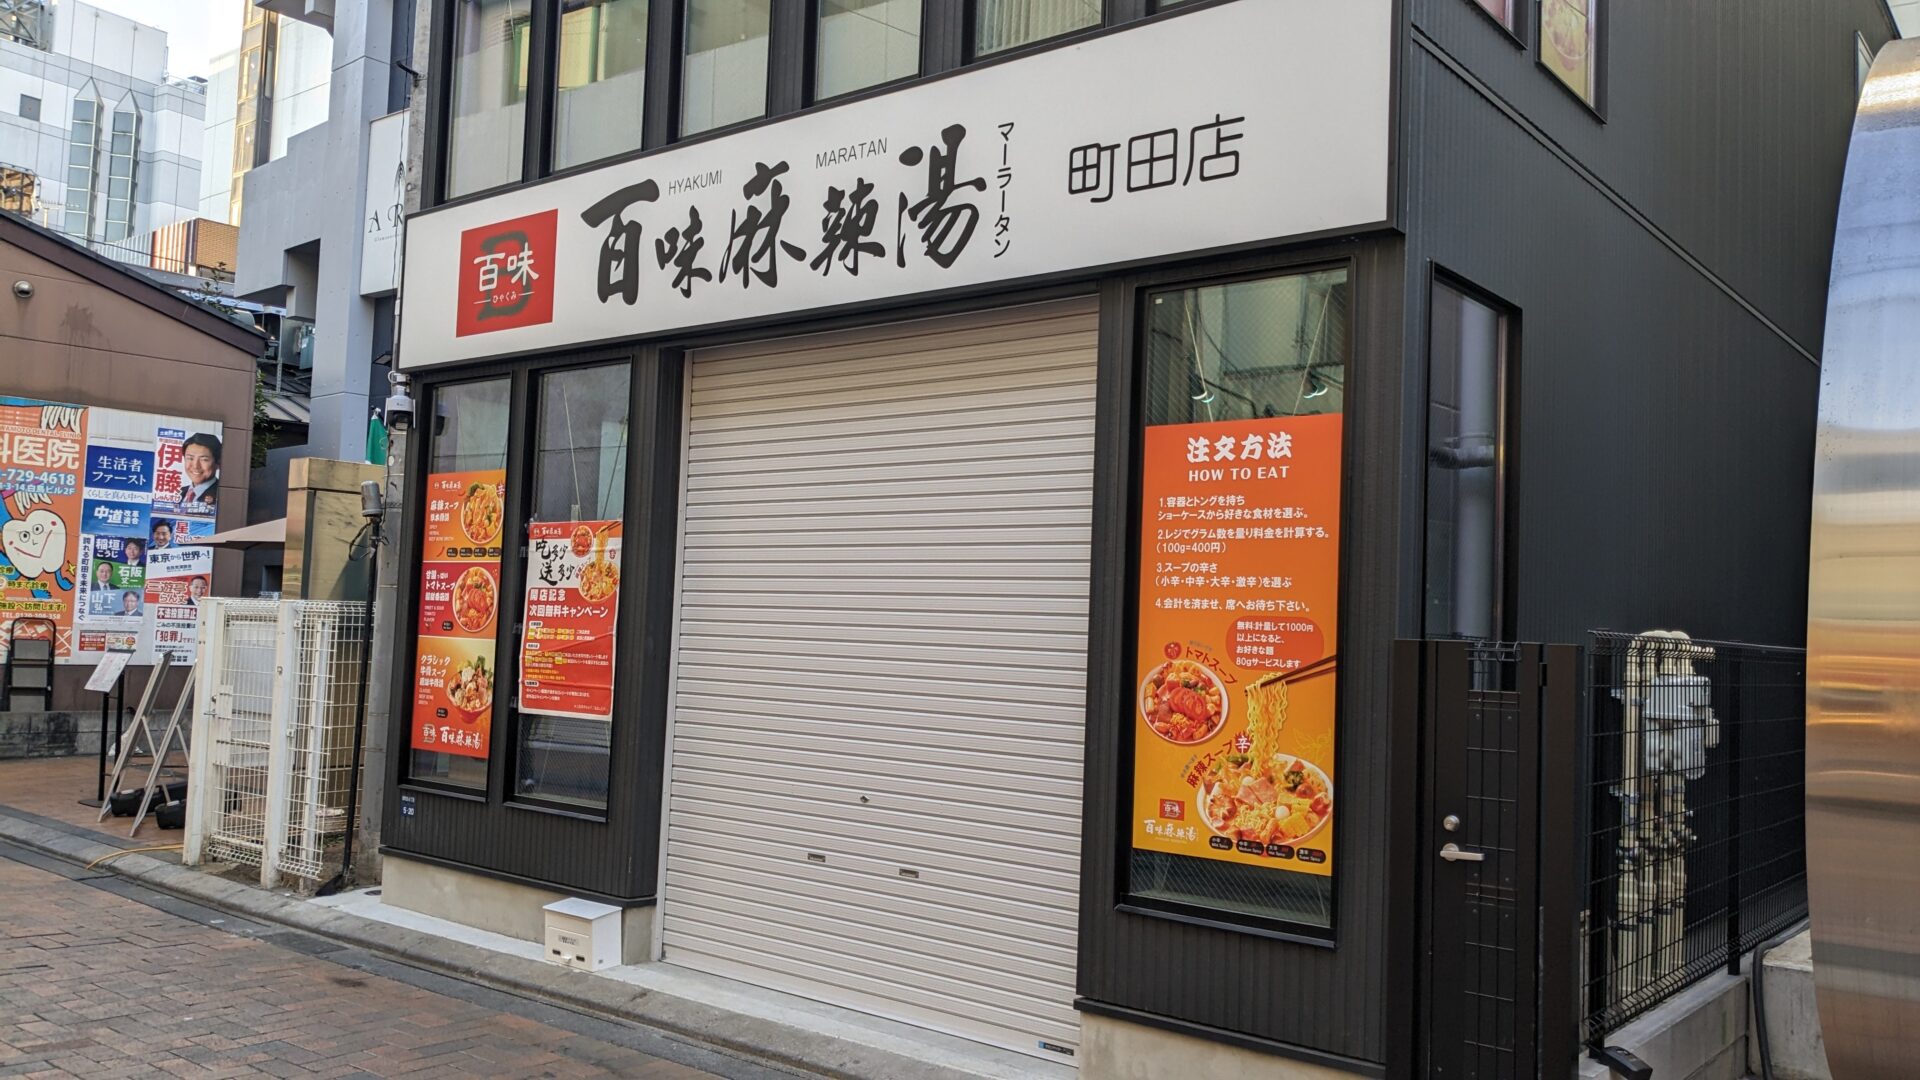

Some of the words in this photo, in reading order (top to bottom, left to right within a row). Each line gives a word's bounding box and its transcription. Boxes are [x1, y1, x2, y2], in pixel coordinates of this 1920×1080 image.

[816, 137, 888, 169] MARATAN
[1069, 113, 1245, 203] 町田店
[668, 170, 722, 195] HYAKUMI
[994, 122, 1014, 258] マーラータン
[581, 123, 987, 305] 百味麻辣湯
[474, 242, 540, 292] 百味
[1187, 432, 1292, 463] 注文方法
[97, 455, 143, 472] 生活者
[156, 443, 183, 494] 伊藤
[92, 471, 146, 486] ファースト
[1188, 469, 1224, 482] HOW
[1231, 467, 1251, 480] TO
[1257, 466, 1290, 479] EAT
[1159, 495, 1245, 508] 1.容器とトングを持ち
[94, 505, 123, 523] 中道
[1158, 507, 1308, 521] ショーケースから好きな食材を選ぶ。
[176, 522, 189, 535] 星
[1158, 527, 1329, 540] 2.レジでグラム数を量り料金を計算する。
[97, 550, 118, 558] こうじ
[149, 550, 210, 564] 東京から世界へ!
[1156, 563, 1218, 574] 3.スープの辛さ
[529, 604, 608, 618] 次回無料キャンペーン
[1155, 598, 1310, 612] 4.会計を済ませ、席へお待ち下さい。
[1236, 633, 1285, 643] 以上になると、
[1236, 646, 1274, 656] お好きな麺
[1235, 656, 1301, 668] 80gサービスします
[1235, 735, 1250, 754] 辛
